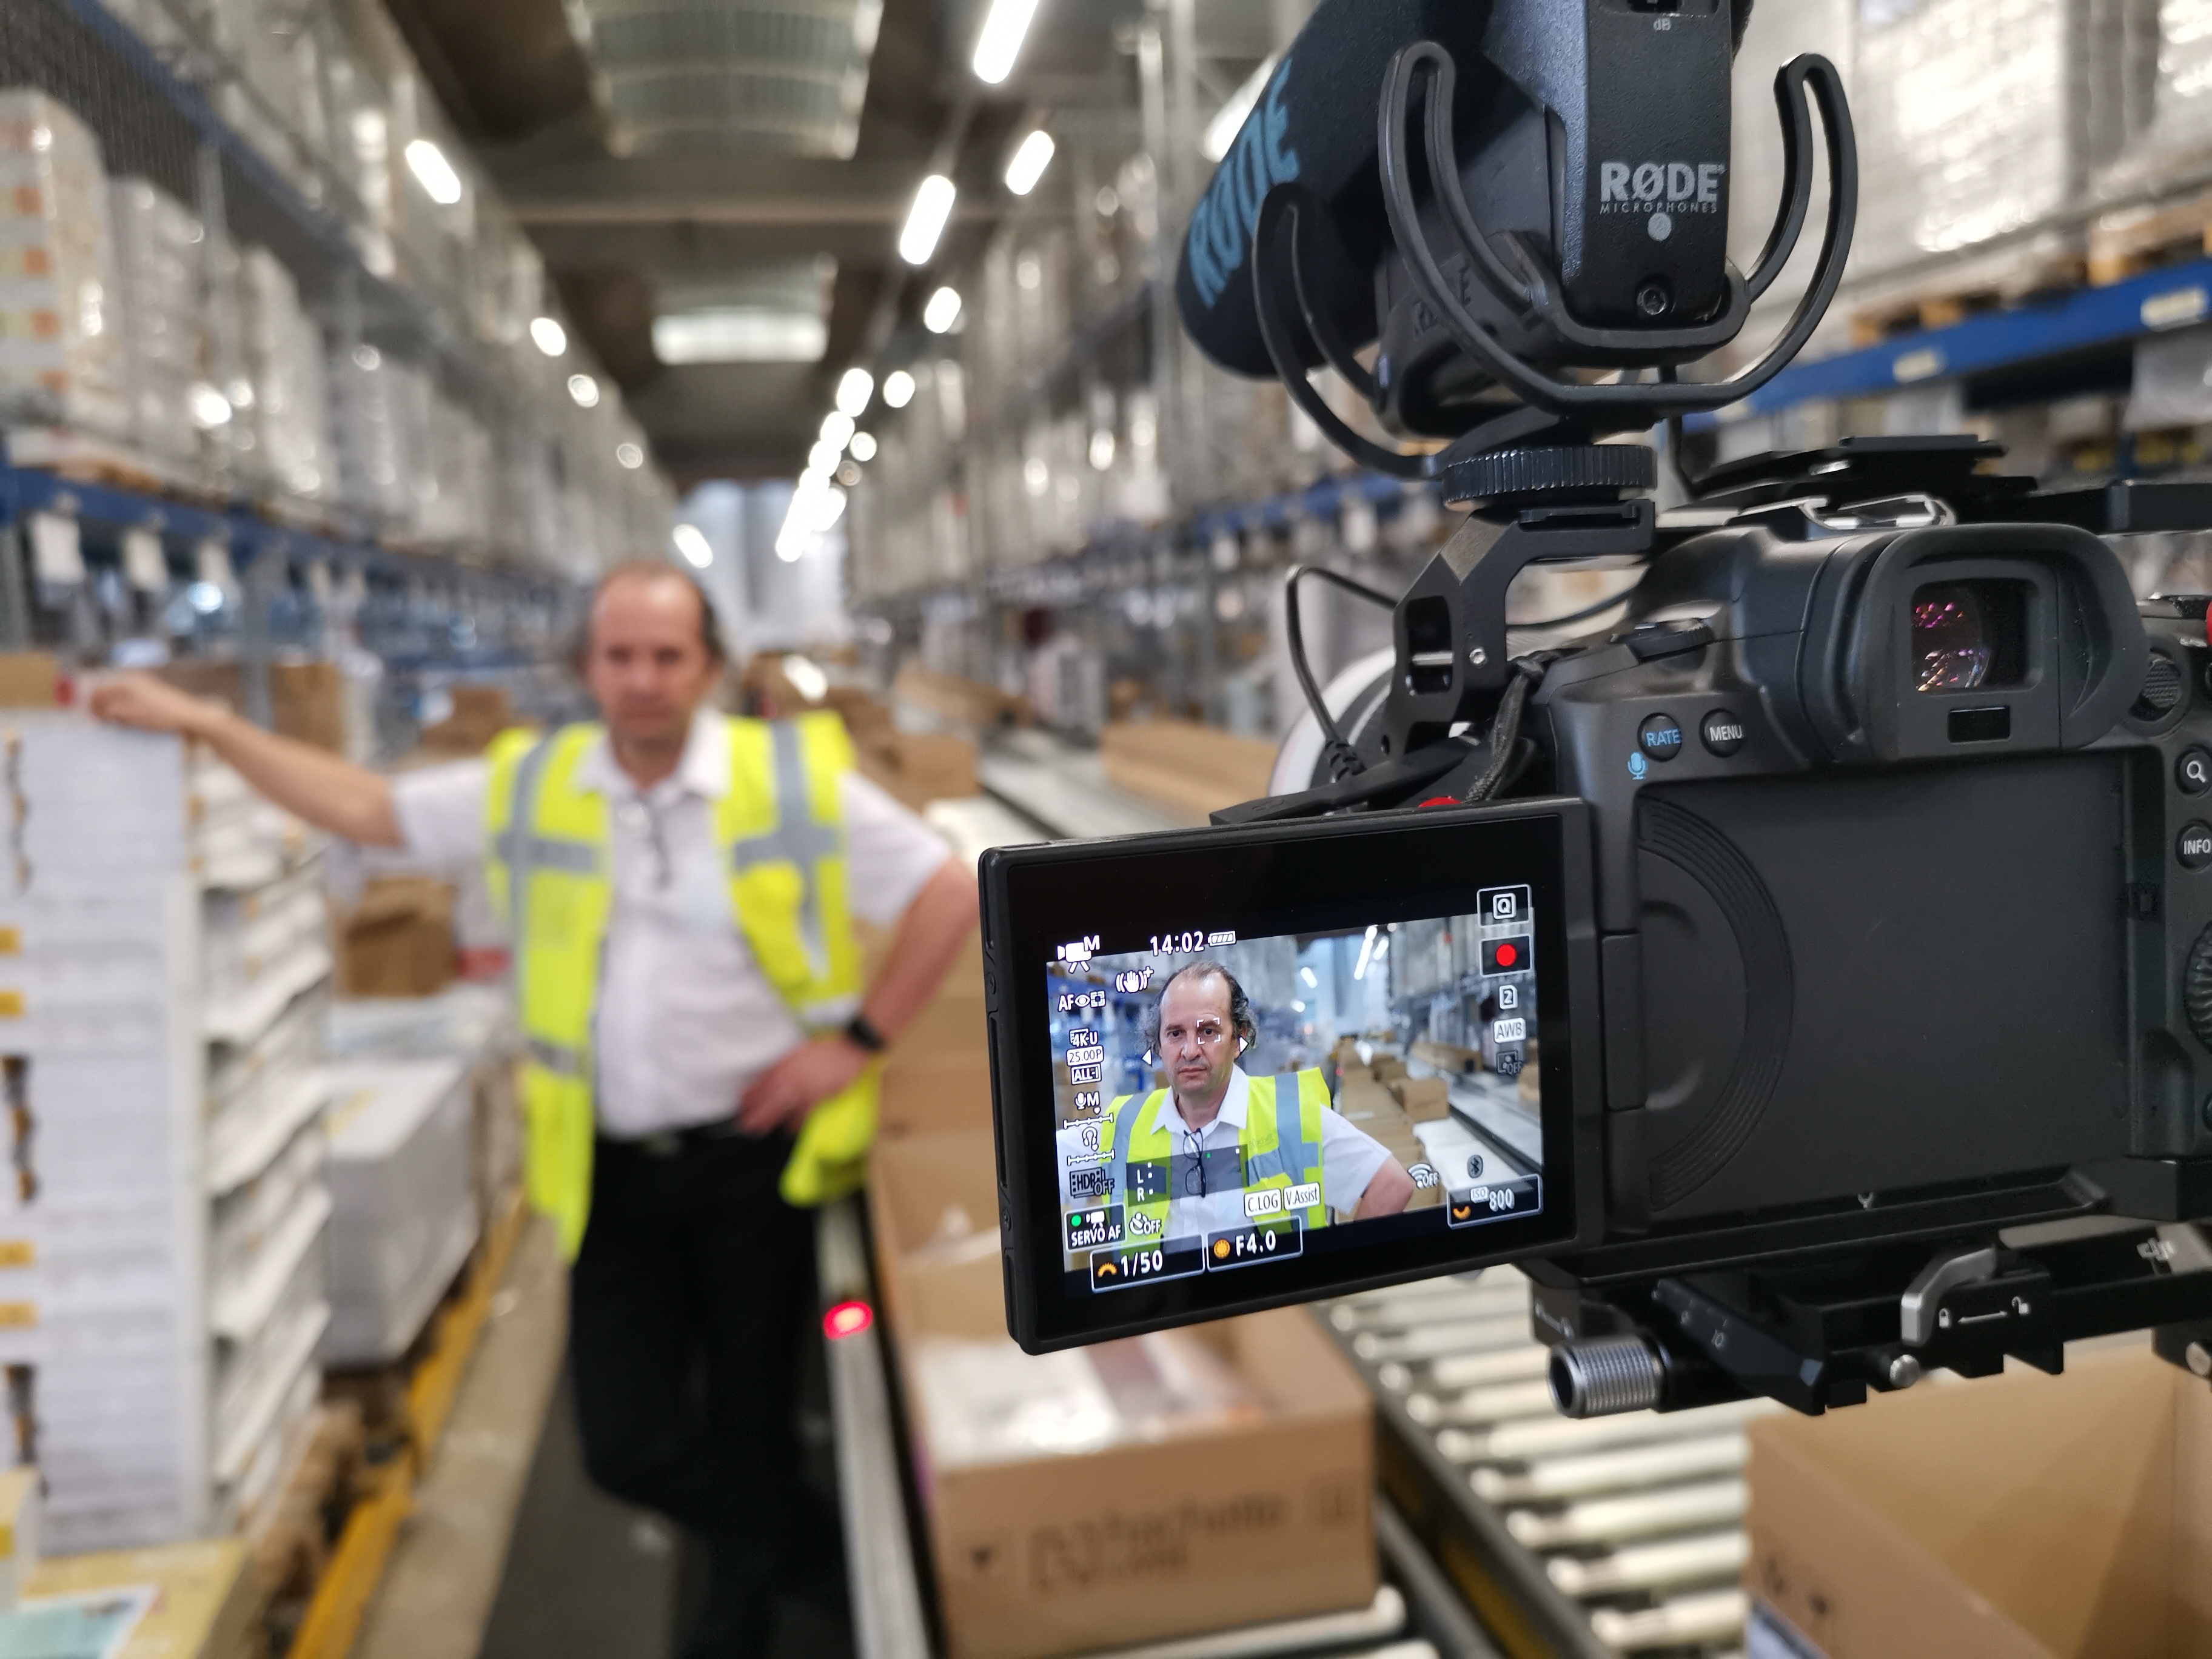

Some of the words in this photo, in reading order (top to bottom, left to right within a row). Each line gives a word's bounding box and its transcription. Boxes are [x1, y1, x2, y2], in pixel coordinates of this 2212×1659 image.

[1653, 18, 1672, 31] dB
[1600, 162, 1720, 203] RØDE
[1600, 201, 1718, 215] MICROPHONES
[1646, 728, 1682, 747] RATE
[1709, 725, 1744, 742] MENU
[2184, 839, 2211, 855] INFO
[1497, 897, 1512, 914] Q
[1150, 931, 1205, 956] 14:02
[1058, 994, 1074, 1011] AF
[1503, 990, 1513, 1004] 2
[1496, 1021, 1522, 1039] AWB
[1073, 1031, 1098, 1047] 4K-U
[1069, 1048, 1102, 1063] 25.00P
[1087, 1091, 1100, 1106] M
[1076, 1172, 1095, 1190] HDR
[1094, 1178, 1114, 1195] OFF
[1423, 1171, 1439, 1188] OFF
[1247, 1193, 1278, 1212] C.LOG
[1285, 1186, 1318, 1206] V.Assist
[1472, 1188, 1486, 1199] ISO
[1489, 1188, 1515, 1212] 800
[1071, 1227, 1105, 1247] SERVO
[1108, 1224, 1122, 1241] AF
[1144, 1219, 1161, 1235] OFF
[1235, 1230, 1276, 1257] F4.0
[1121, 1250, 1163, 1277] 1/50
